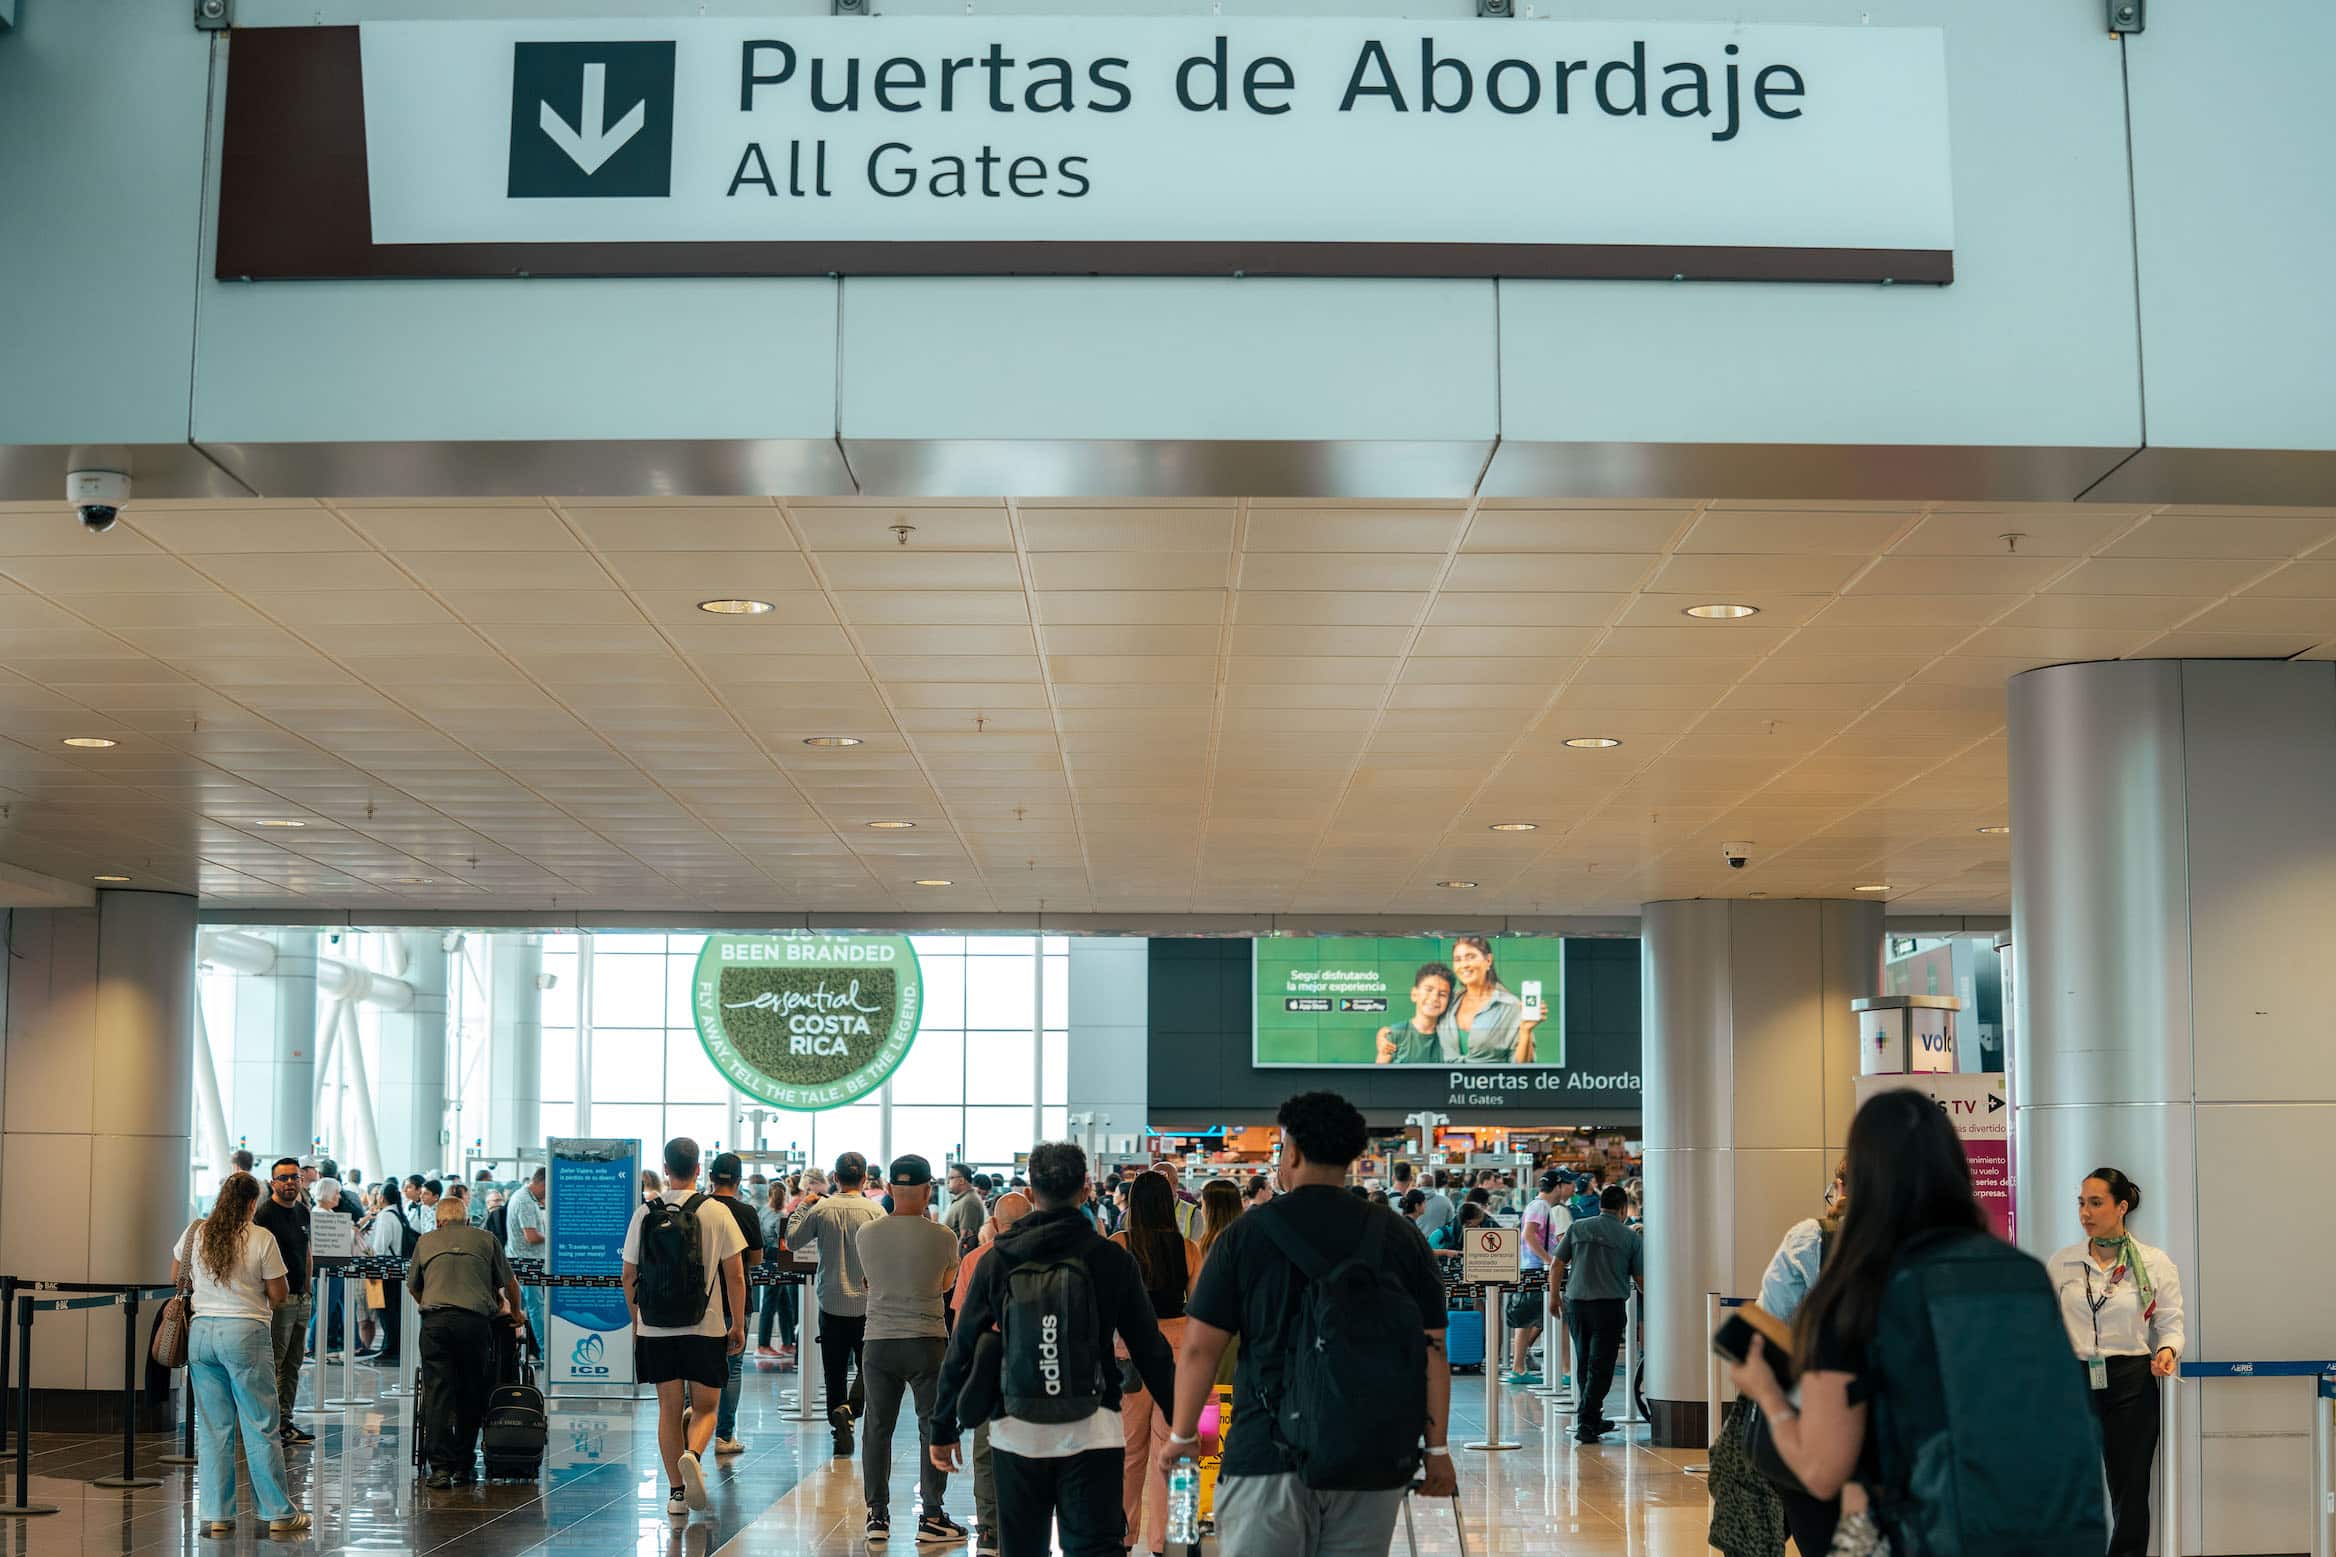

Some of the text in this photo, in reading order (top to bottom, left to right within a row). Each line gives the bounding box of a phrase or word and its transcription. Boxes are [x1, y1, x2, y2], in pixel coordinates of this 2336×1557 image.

[739, 35, 1806, 143] Puertas de Abordaje
[727, 140, 1091, 199] All Gates
[721, 944, 896, 962] BEEN BRANDED
[1321, 969, 1379, 981] disfrutando
[1286, 981, 1387, 993] la mejor experiencia
[724, 978, 882, 1017] essential
[788, 1014, 871, 1036] COSTA
[698, 981, 918, 1105] FLY AWAY. TELL THE TALE. BE THE LEGEND.
[788, 1035, 849, 1057] RICA
[1449, 1071, 1643, 1094] Puertas de Aborda
[1448, 1094, 1504, 1105] All Gates
[1951, 1099, 1977, 1115] TV
[1968, 1123, 2007, 1133] divertido
[1979, 1167, 2000, 1176] vuelo
[1975, 1178, 1998, 1187] series
[1972, 1190, 2007, 1199] orpresas.
[1038, 1315, 1061, 1396] adidas
[571, 1366, 608, 1374] ICD
